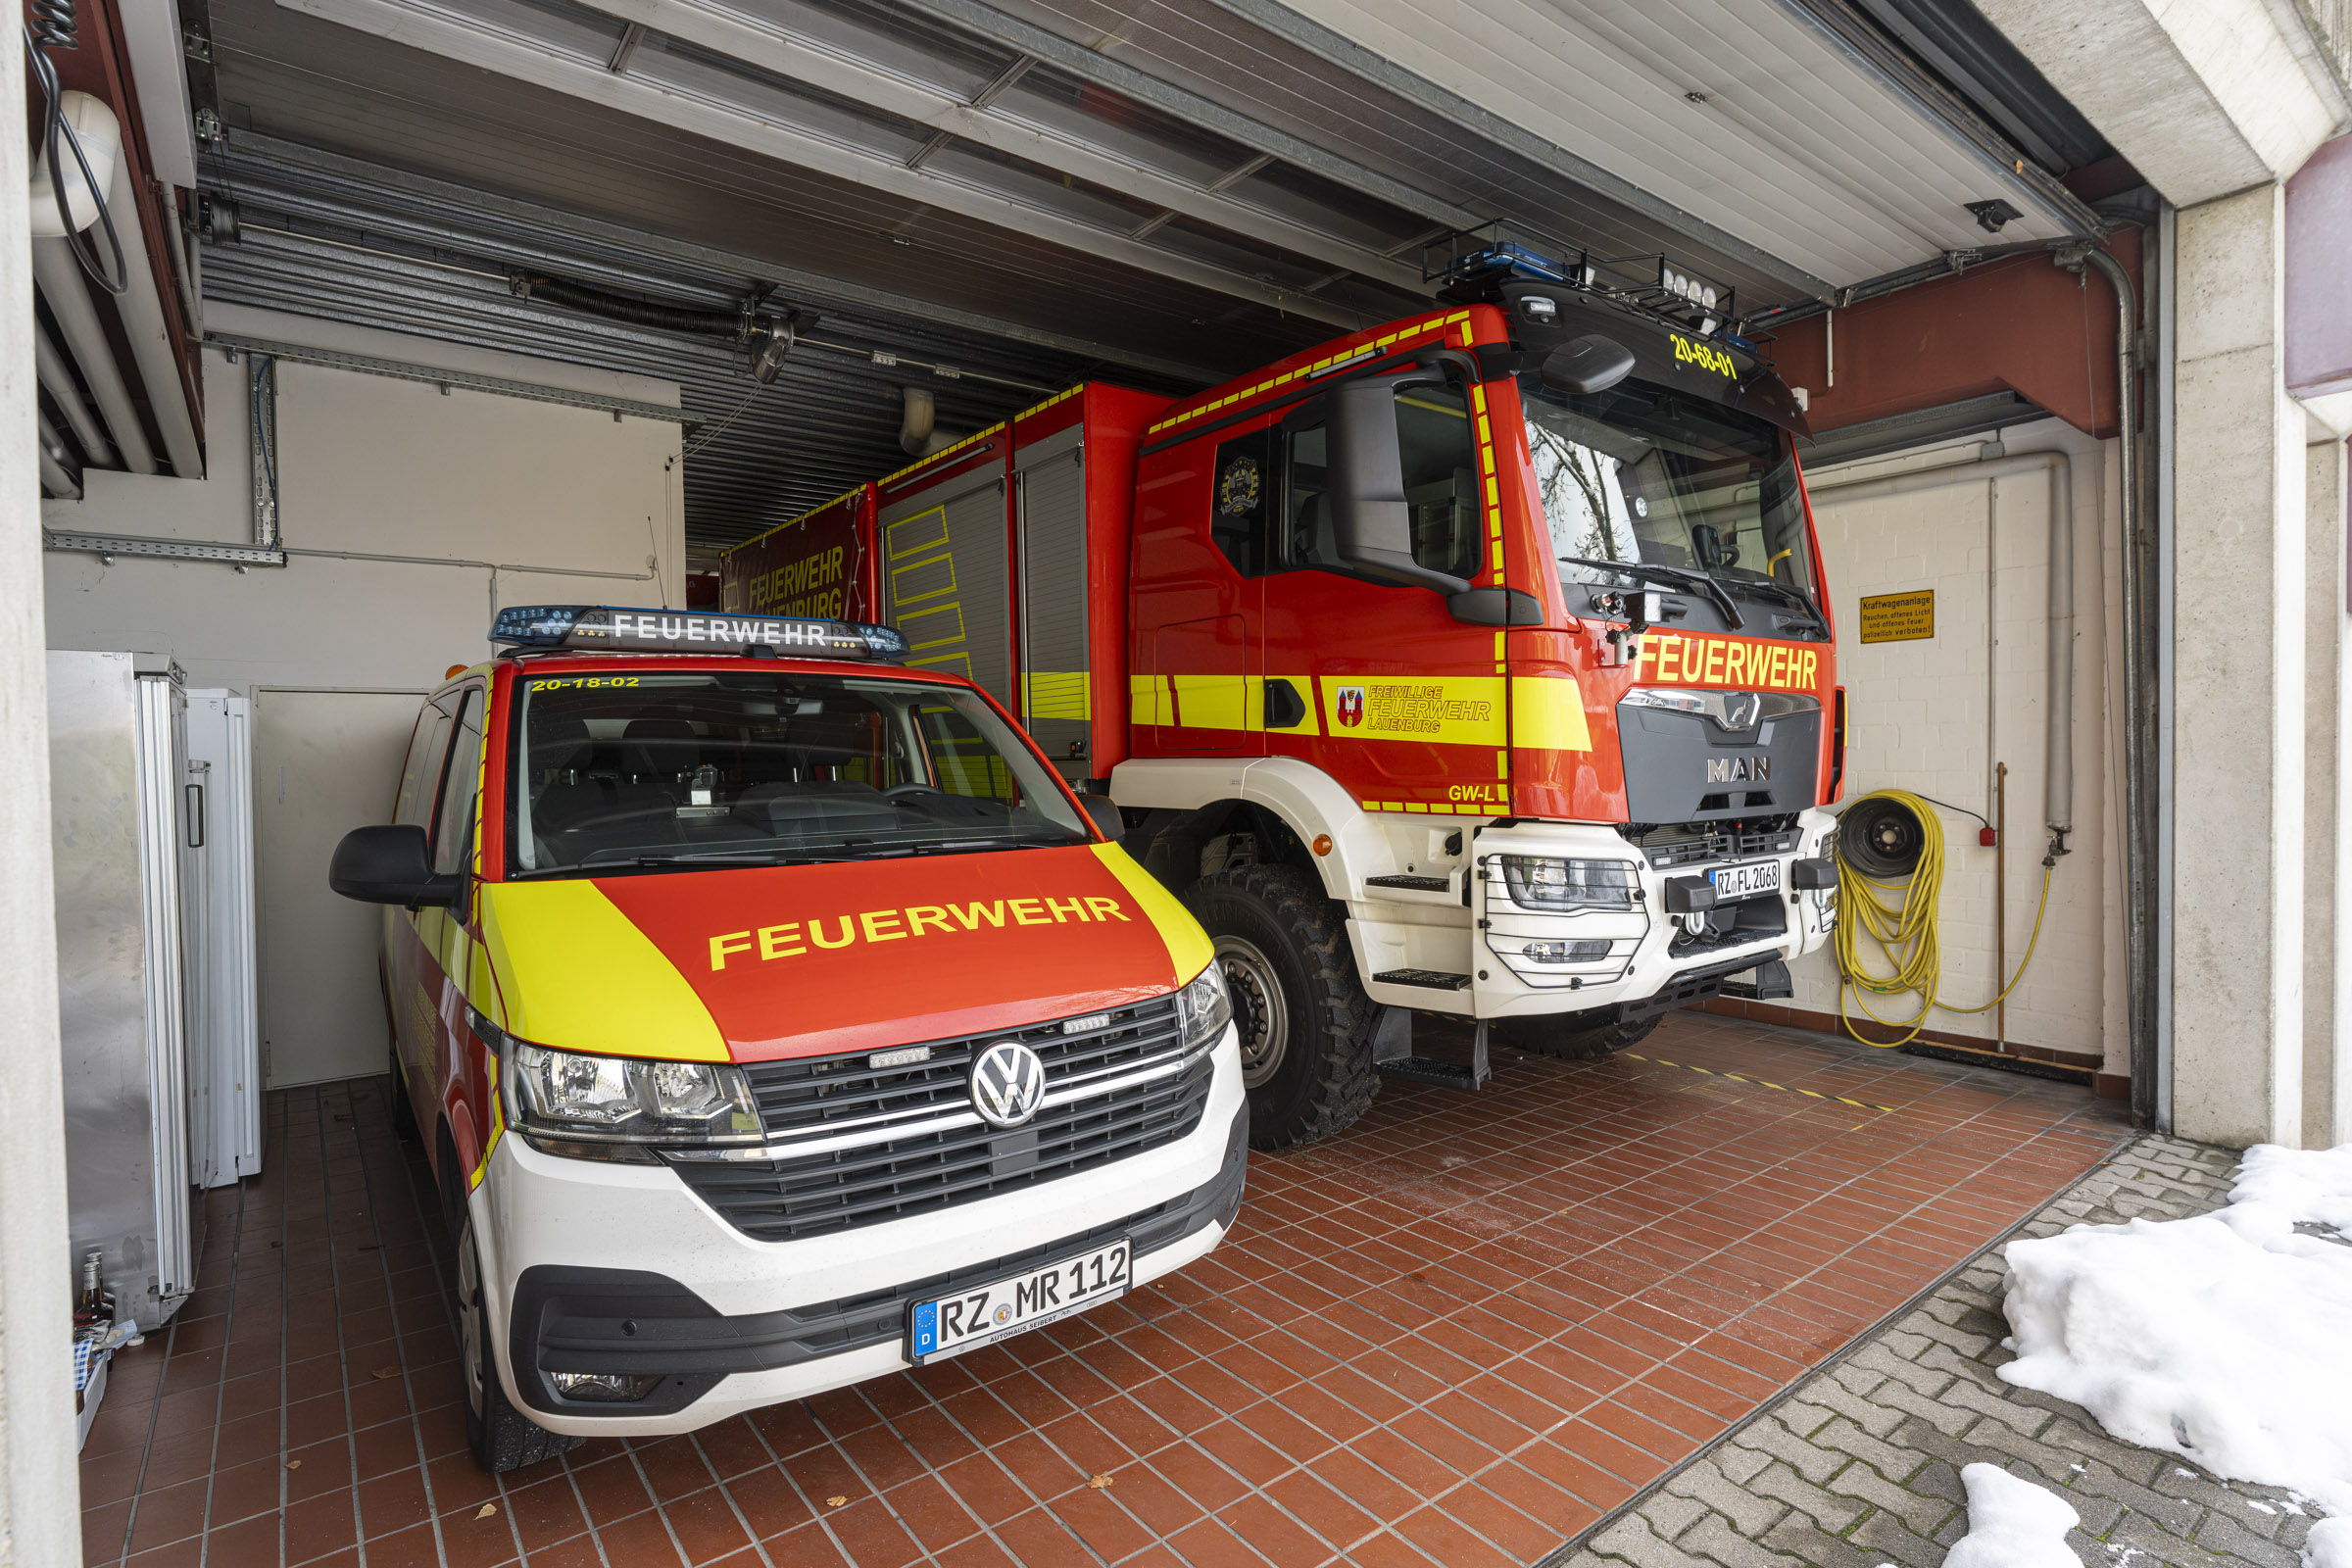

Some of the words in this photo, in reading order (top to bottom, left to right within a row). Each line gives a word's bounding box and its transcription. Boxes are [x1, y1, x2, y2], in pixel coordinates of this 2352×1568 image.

[1670, 334, 1738, 380] 20-68-01
[749, 545, 844, 611] FEUERWEHR
[1863, 596, 1931, 611] Kraftwagenanlage
[613, 614, 826, 647] FEUERWEHR
[1863, 630, 1892, 639] polizeilich
[1895, 624, 1931, 635] verboten!
[1634, 634, 1817, 690] FEUERWEHR
[530, 676, 641, 692] 20-18-02
[1368, 685, 1443, 699] FREIWILLIGE
[1368, 699, 1492, 721] FEUERWEHR
[1367, 717, 1441, 733] LAUENBURG
[1707, 757, 1771, 784] MAN
[1448, 784, 1495, 803] GW-L
[1718, 872, 1731, 896] RZ
[1738, 869, 1751, 893] FL
[1753, 864, 1777, 889] 2068
[709, 897, 1132, 971] FEUERWEHR
[921, 1333, 930, 1347] D
[941, 1291, 990, 1342] RZ
[1016, 1270, 1060, 1318] MR
[1069, 1247, 1127, 1299] 112
[989, 1325, 1027, 1344] AUTOHAUS
[1029, 1314, 1057, 1330] SEIBERT
